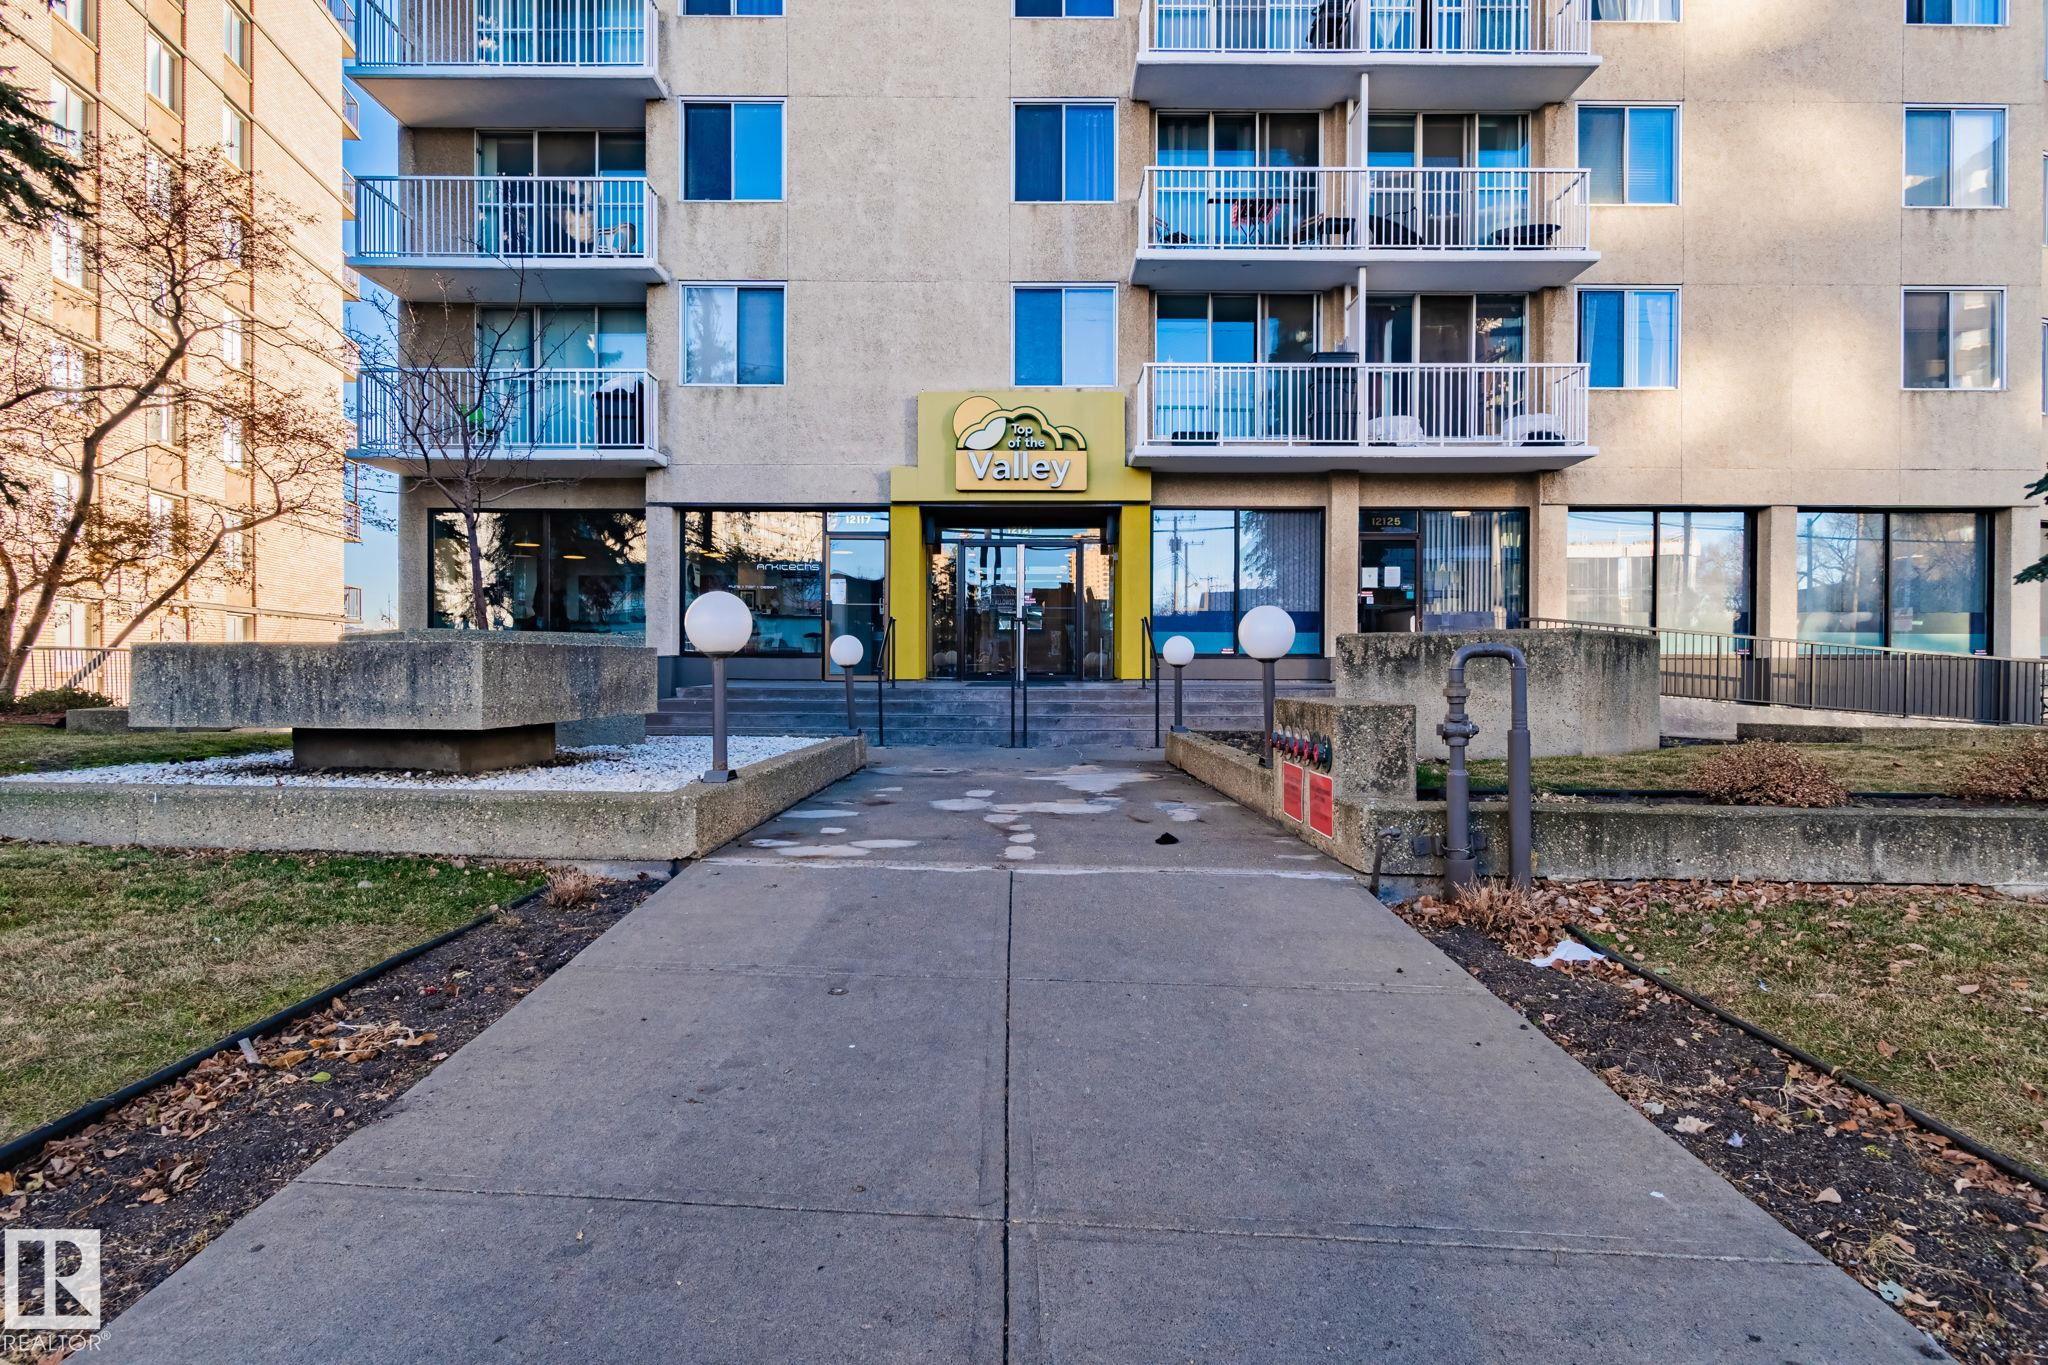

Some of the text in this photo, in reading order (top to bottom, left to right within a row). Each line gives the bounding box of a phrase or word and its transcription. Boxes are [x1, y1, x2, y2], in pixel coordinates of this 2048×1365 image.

[1011, 423, 1033, 437] Top
[1008, 437, 1045, 448] of the
[967, 450, 1071, 488] Valley
[845, 515, 871, 524] 12117
[1372, 517, 1401, 526] 12125
